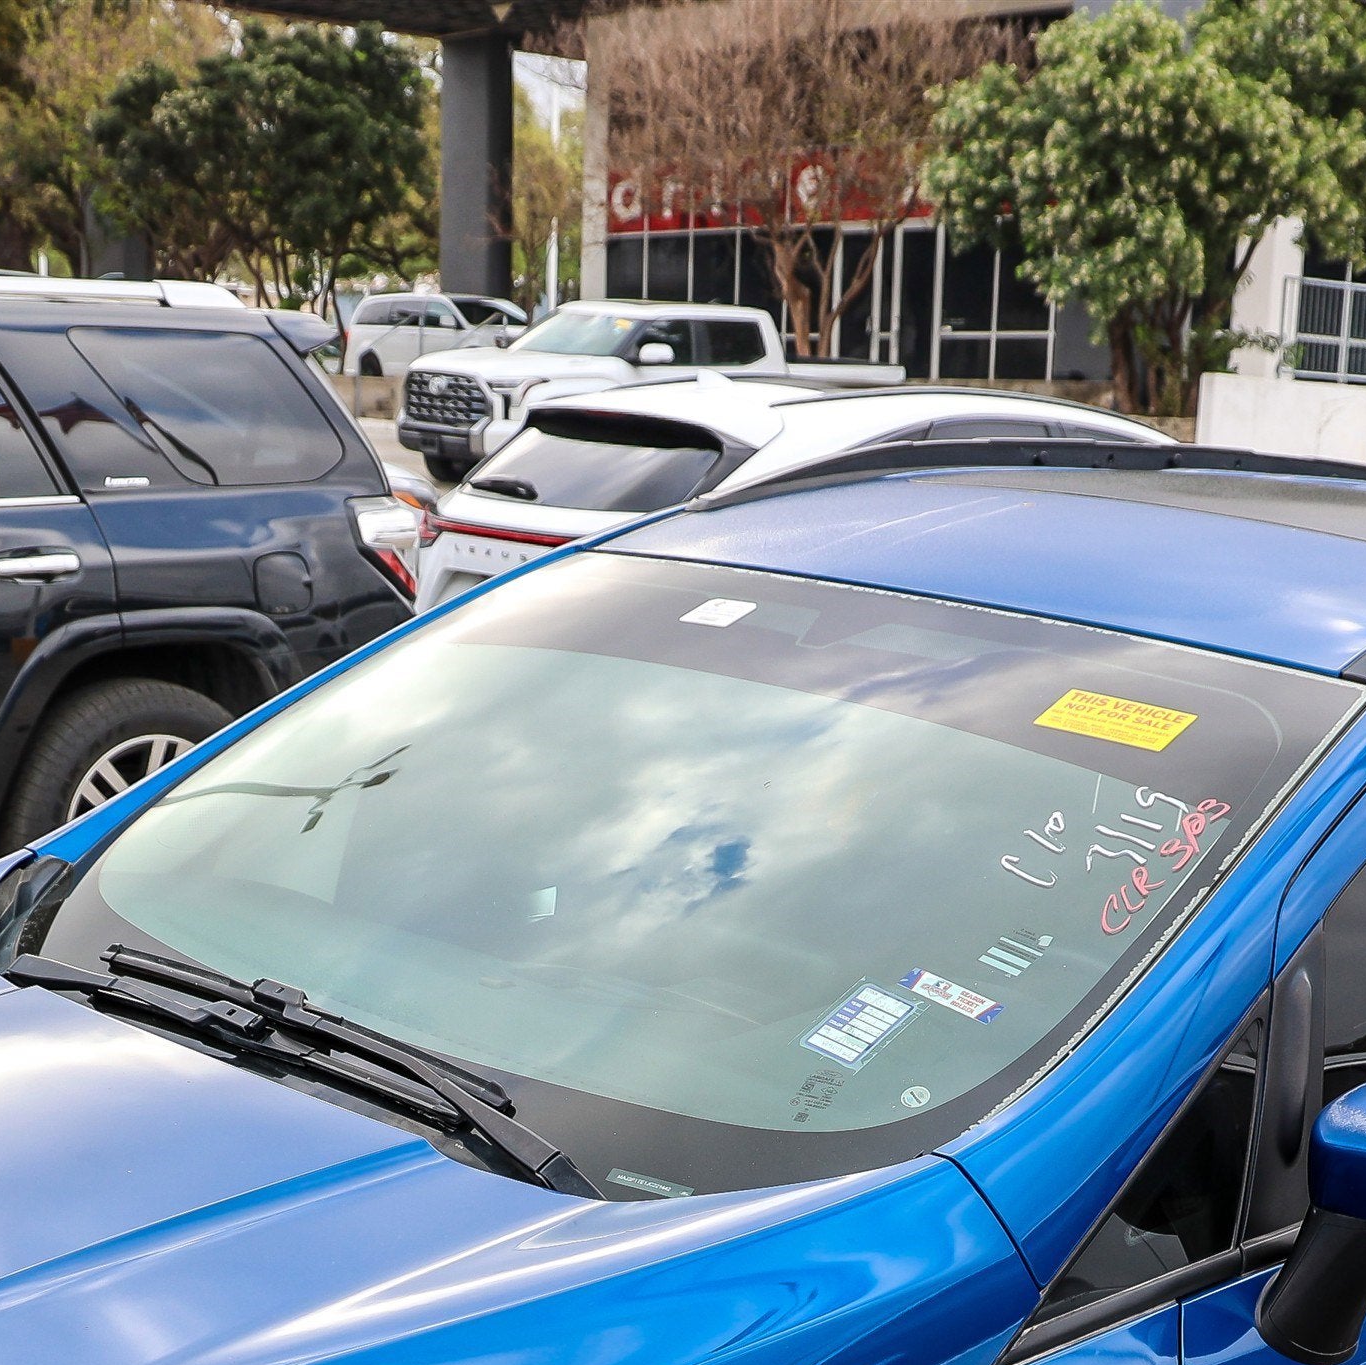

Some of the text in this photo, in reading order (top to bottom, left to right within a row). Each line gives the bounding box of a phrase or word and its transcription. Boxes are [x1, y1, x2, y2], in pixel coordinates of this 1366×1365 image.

[453, 542, 528, 562] LEXUS
[1064, 702, 1173, 731] NOT FOR SALE
[1071, 692, 1110, 707] THIS
[1113, 701, 1188, 724] VEHICLE
